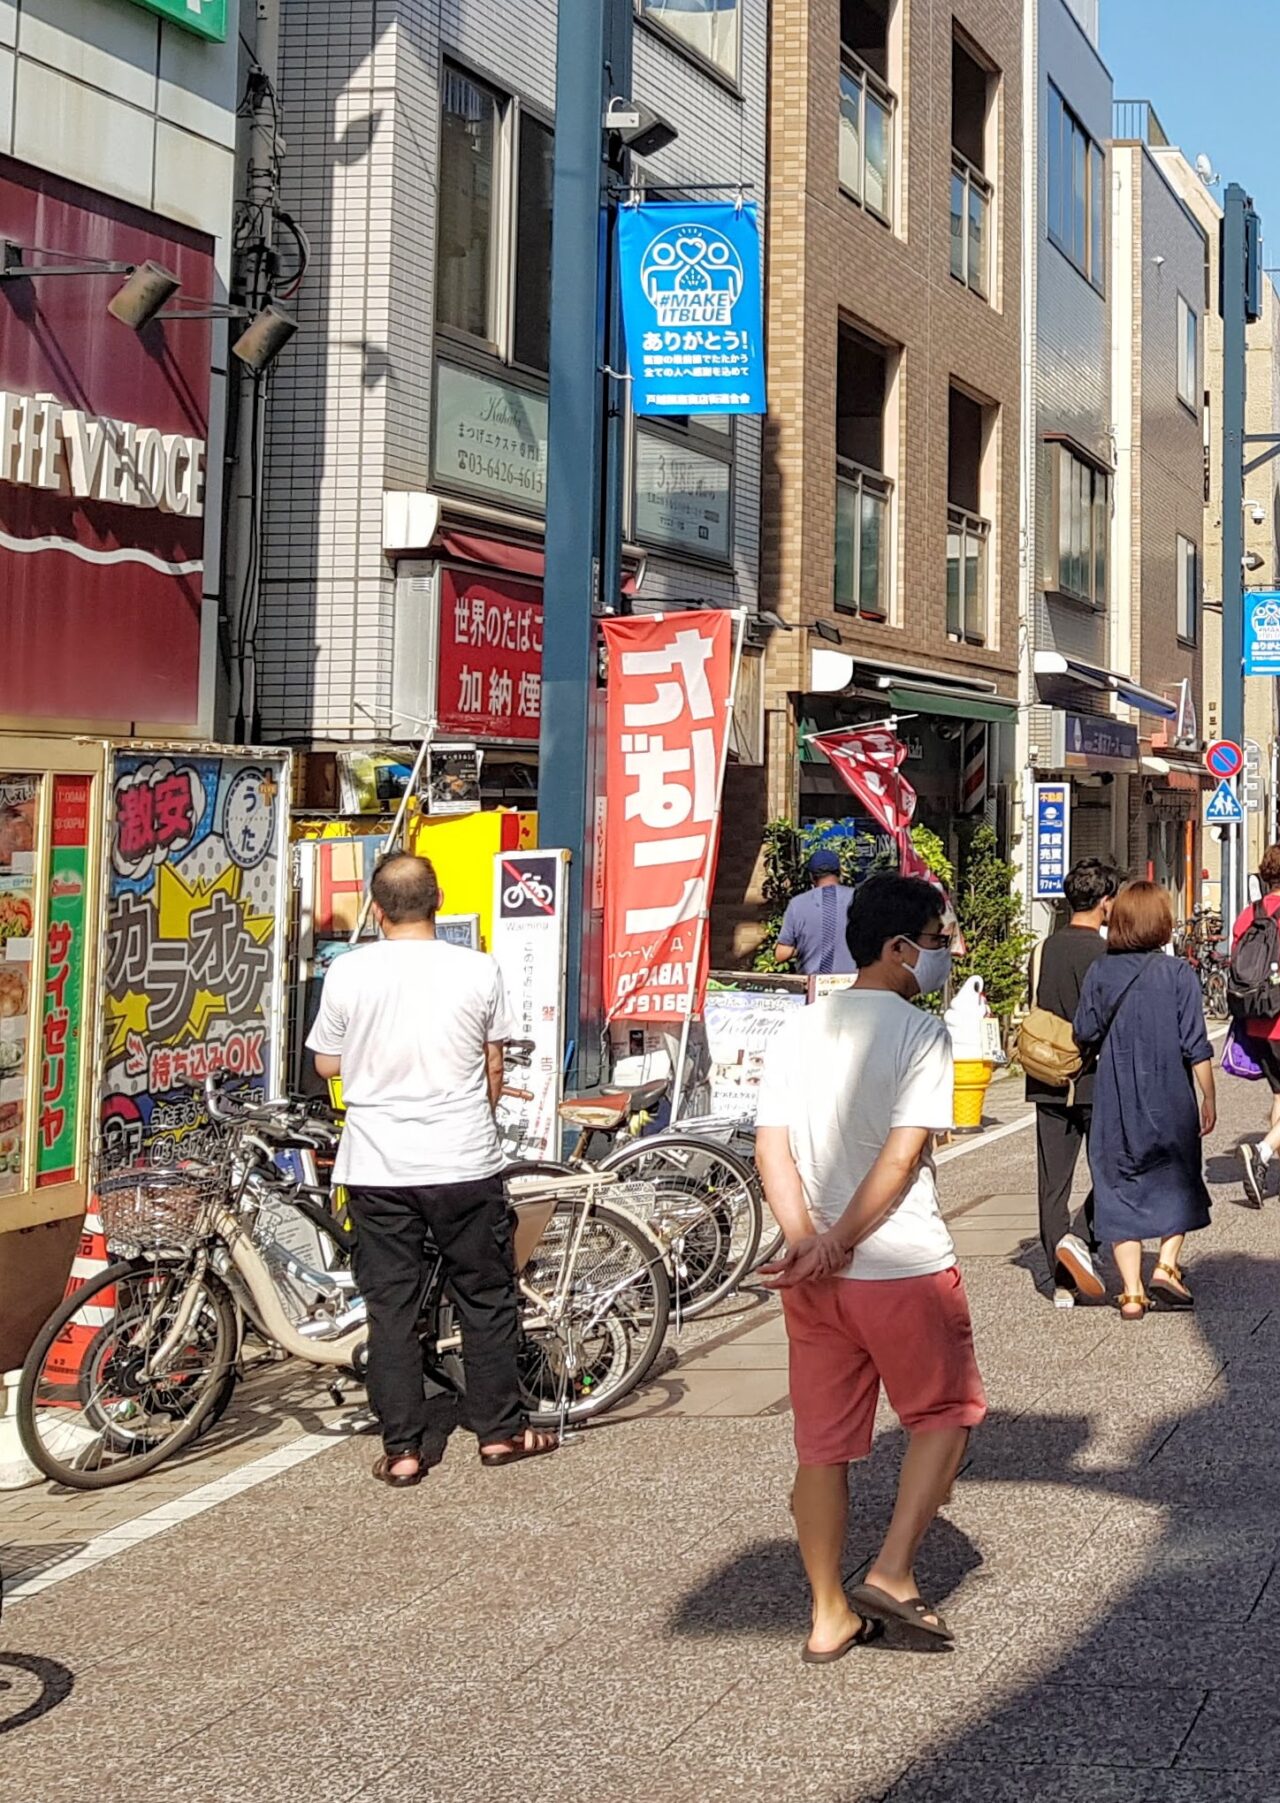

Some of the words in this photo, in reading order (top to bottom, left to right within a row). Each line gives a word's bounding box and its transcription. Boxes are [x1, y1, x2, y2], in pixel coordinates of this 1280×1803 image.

[659, 292, 729, 308] #MAKE
[661, 307, 726, 323] ITBLUE
[642, 330, 748, 350] ありがとう!
[62, 409, 205, 518] VELOCE
[108, 894, 271, 1040] カラオケ
[38, 919, 73, 1149] サイゼリヤ
